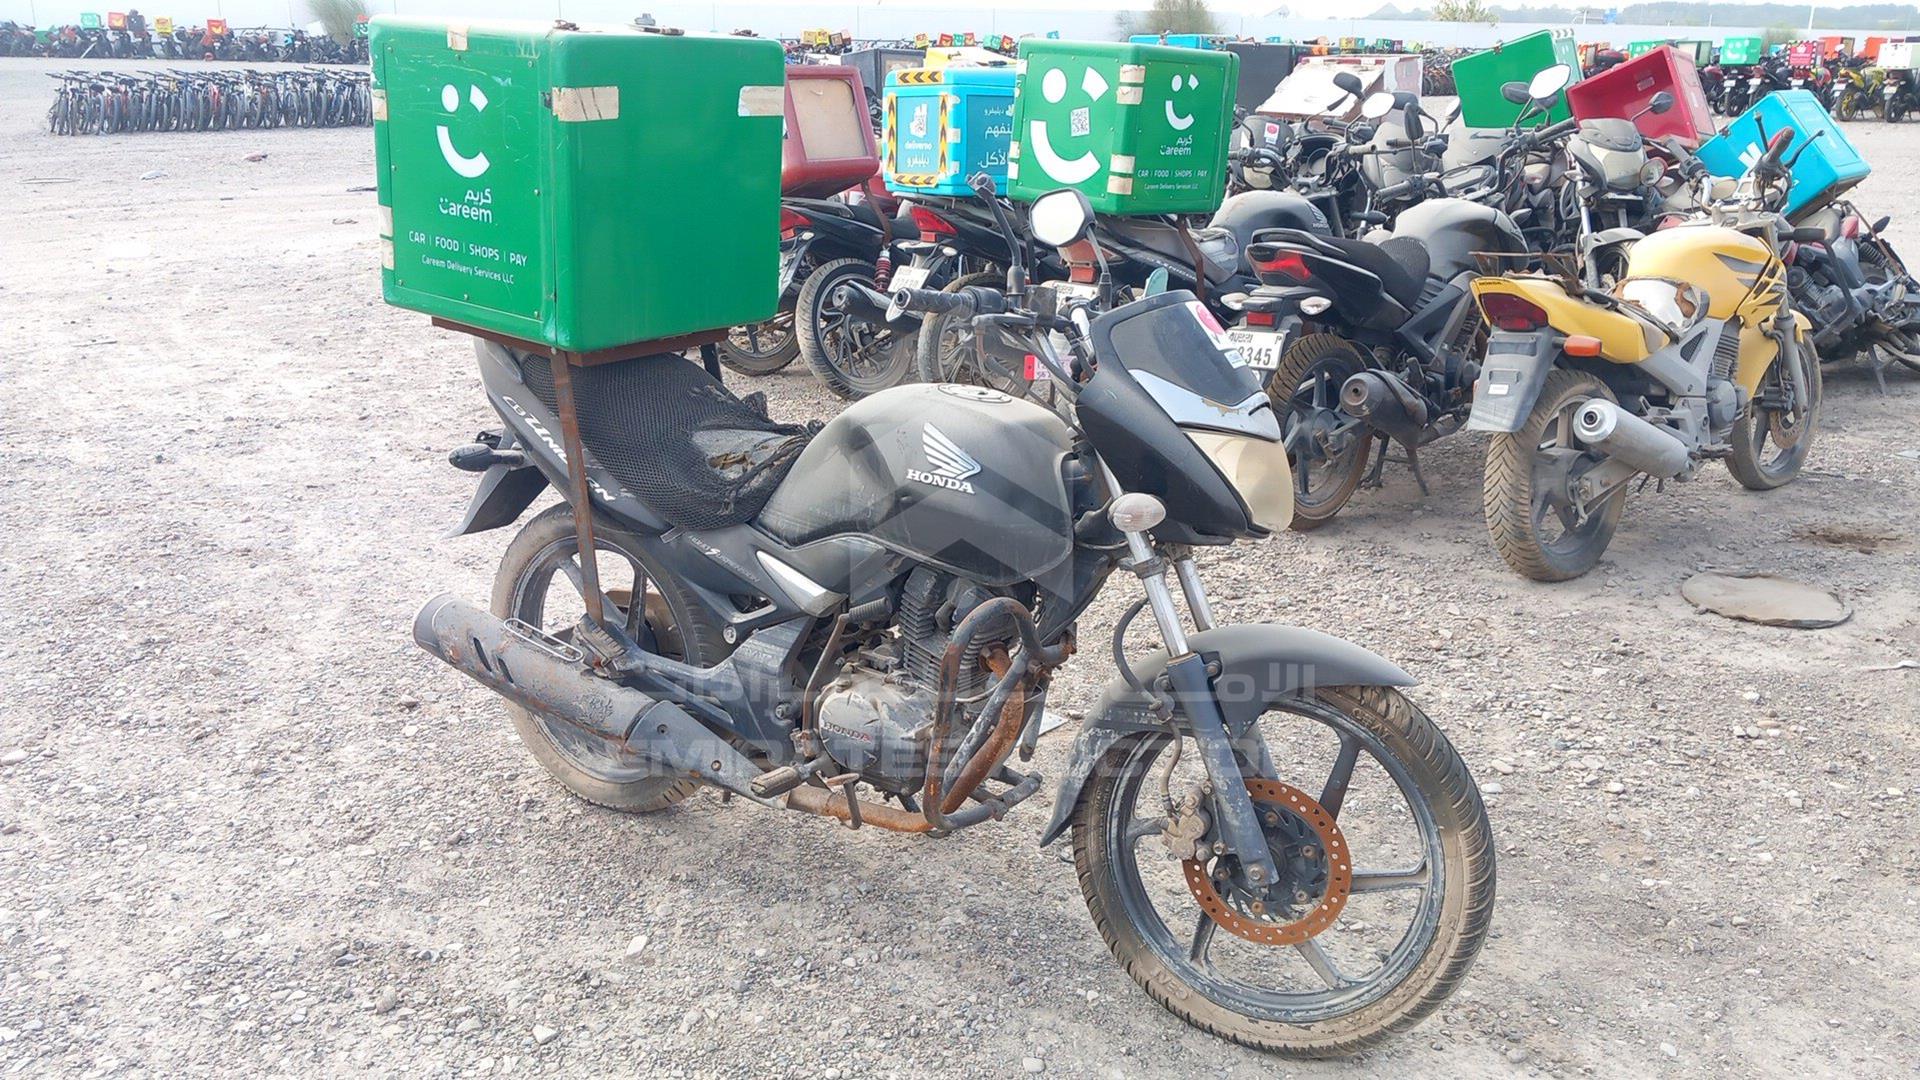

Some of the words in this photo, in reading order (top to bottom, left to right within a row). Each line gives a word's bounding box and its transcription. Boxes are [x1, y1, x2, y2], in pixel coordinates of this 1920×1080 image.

[1160, 145, 1192, 155] Careem
[1137, 169, 1149, 177] CAR
[1154, 169, 1169, 177] FOOD
[439, 197, 493, 223] Careem
[464, 188, 492, 206] كريم
[409, 231, 426, 244] CAR
[435, 236, 460, 252] FOOD
[469, 243, 500, 261] SHOPS
[509, 253, 528, 267] PAY
[421, 254, 446, 269] Careem
[446, 260, 473, 275] Delivery
[473, 266, 502, 281] Services
[502, 274, 515, 285] LLC
[524, 413, 616, 501] UNICRN
[907, 469, 975, 495] HONDA
[823, 721, 872, 744] HONDA
